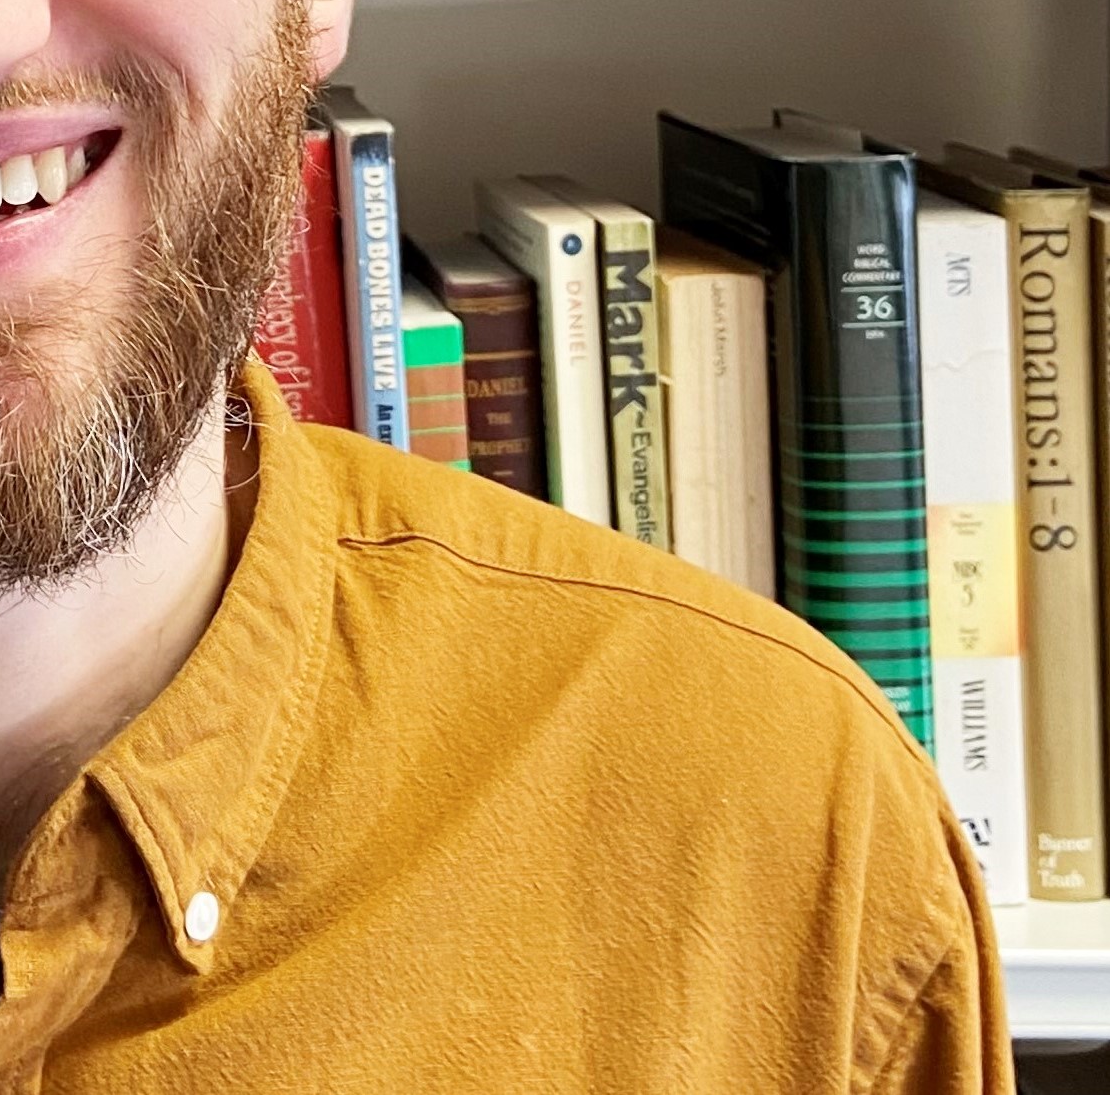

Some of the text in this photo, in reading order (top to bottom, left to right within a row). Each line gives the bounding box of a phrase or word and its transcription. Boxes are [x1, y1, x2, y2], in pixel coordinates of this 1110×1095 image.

[362, 166, 398, 392] DEAD BONES LIVE
[856, 294, 894, 321] 36
[944, 251, 972, 297] ACTS
[565, 279, 587, 364] DANIEL
[606, 248, 659, 418] Mark
[960, 679, 988, 772] WILLIAMS
